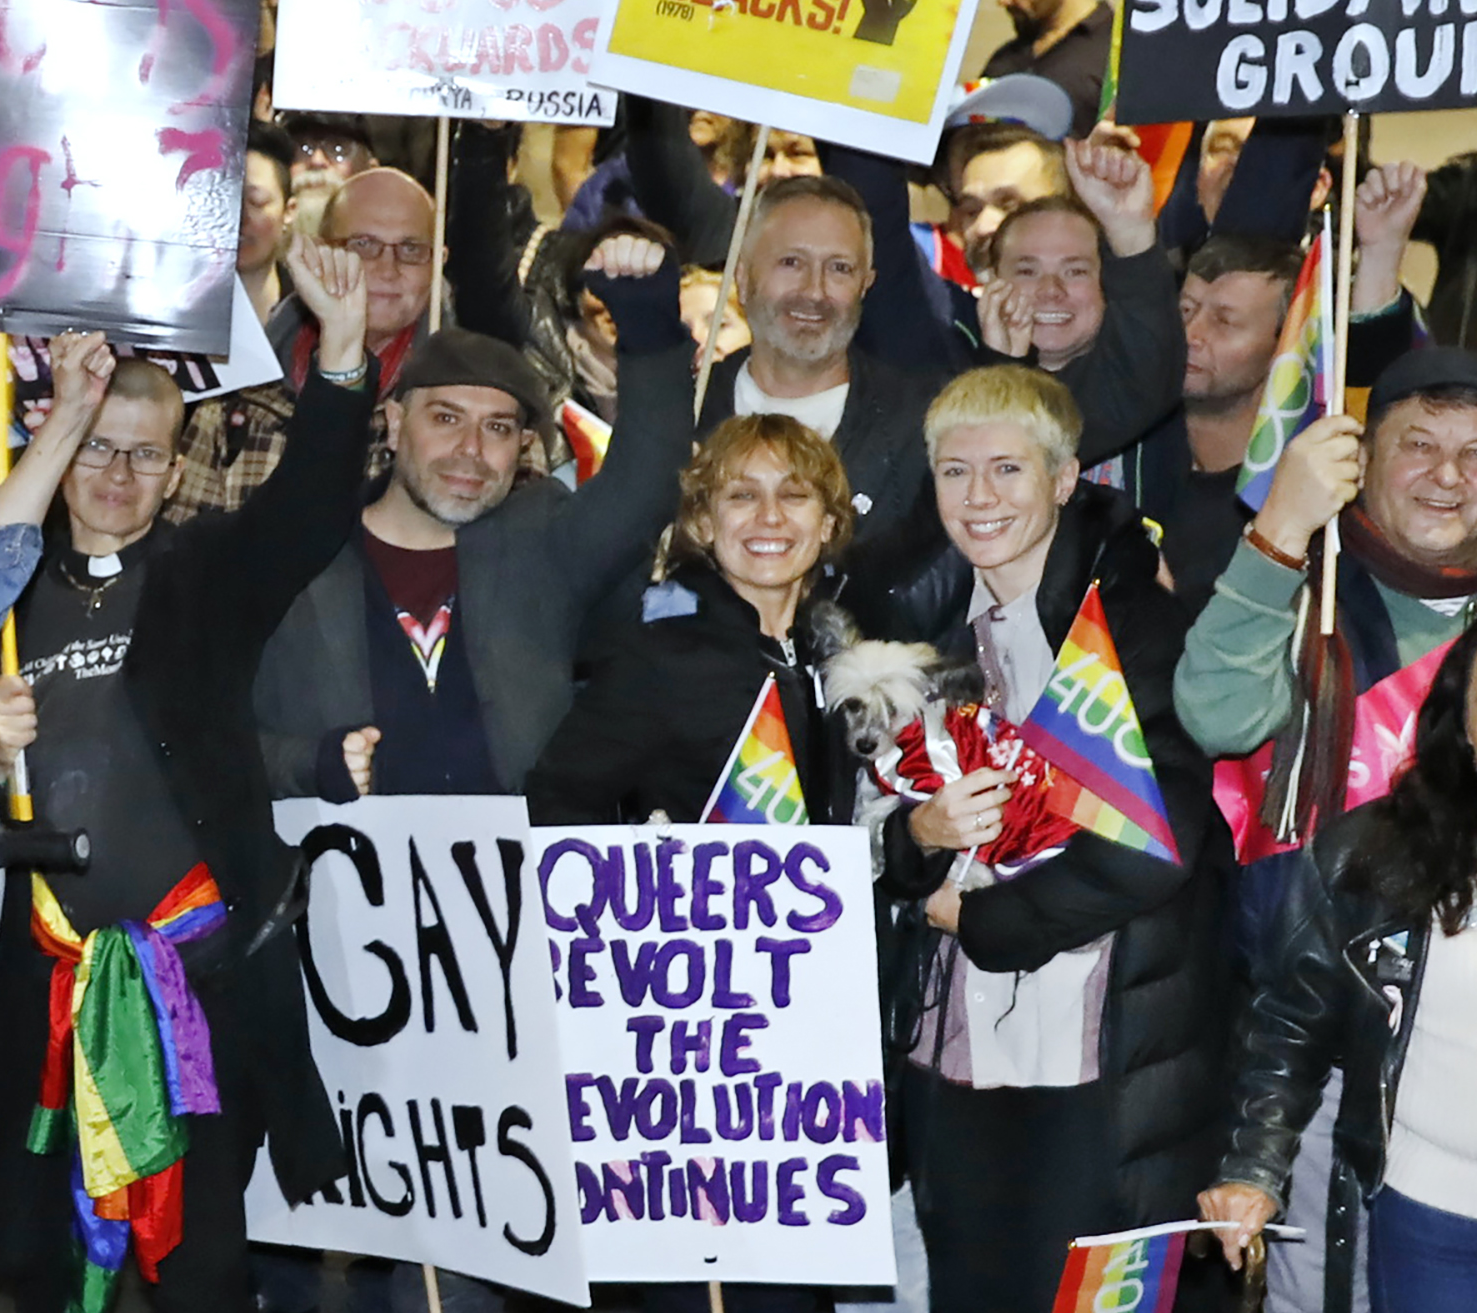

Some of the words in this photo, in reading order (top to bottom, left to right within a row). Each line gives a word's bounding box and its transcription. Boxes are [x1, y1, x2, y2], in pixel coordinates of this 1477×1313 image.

[538, 837, 844, 938] QUEERS
[297, 823, 525, 1061] GAY
[626, 1014, 769, 1077] THE
[565, 1072, 885, 1144] EVOLUTION
[302, 1090, 556, 1257] iGHTS
[578, 1150, 868, 1226] ONTINUES
